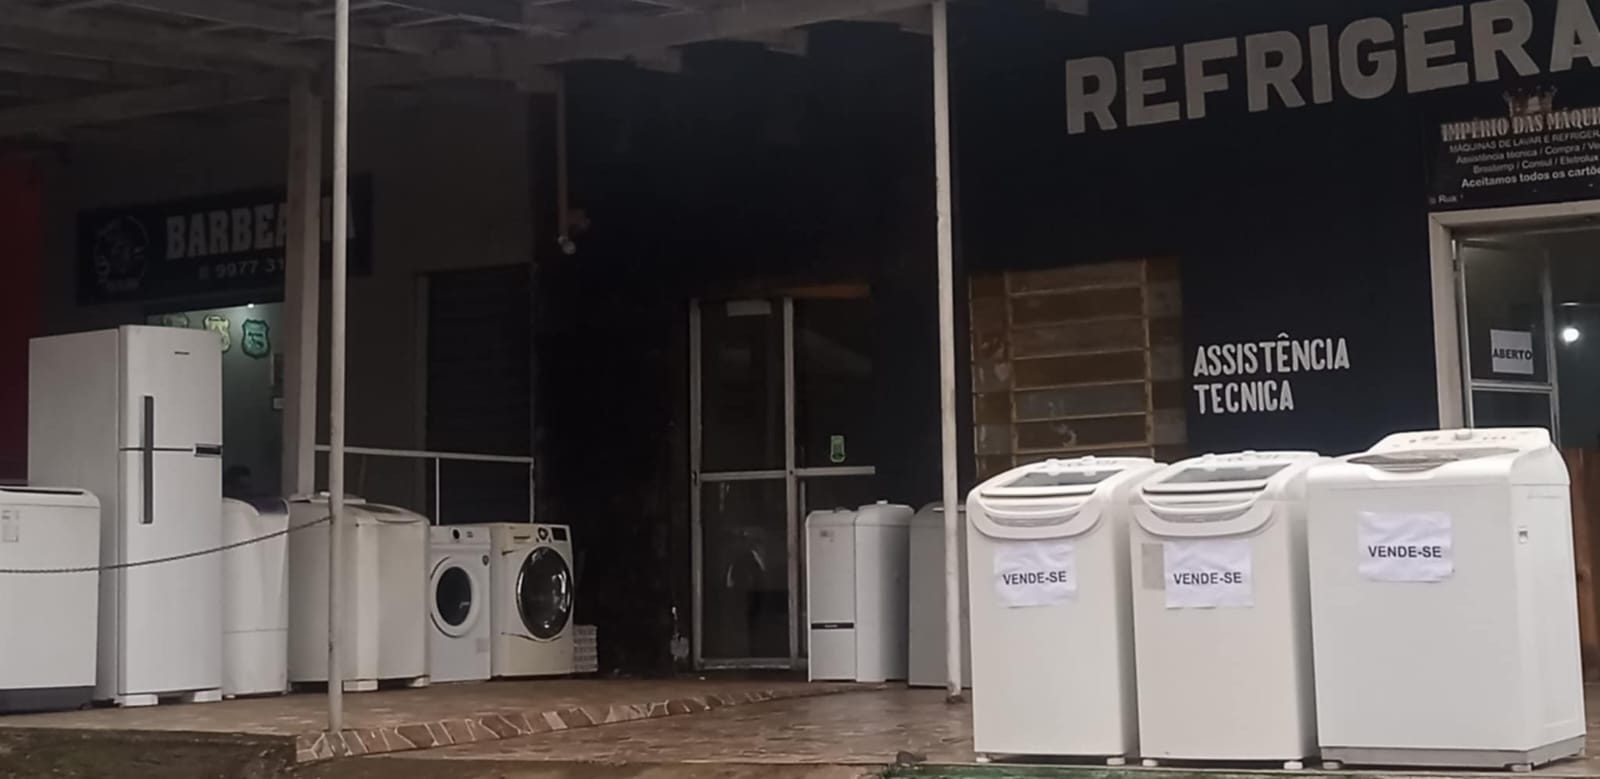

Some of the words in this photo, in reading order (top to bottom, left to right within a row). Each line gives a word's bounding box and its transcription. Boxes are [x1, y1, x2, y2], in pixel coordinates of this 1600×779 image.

[1065, 0, 1600, 134] REFRIGERA
[1440, 117, 1510, 142] IMPÉRIO
[1512, 114, 1544, 134] DAS
[1545, 144, 1580, 156] Compra
[1461, 174, 1517, 189] Aceitamos
[1519, 170, 1550, 183] todos
[1552, 169, 1566, 179] os
[1193, 332, 1351, 377] ASSISTÊNCIA
[1492, 348, 1533, 360] ABERTO
[1193, 380, 1295, 415] TECNICA
[1367, 545, 1443, 559] VENDE-SE
[1002, 570, 1068, 586] VENDE-SE
[1173, 570, 1243, 586] VENDE-SE
